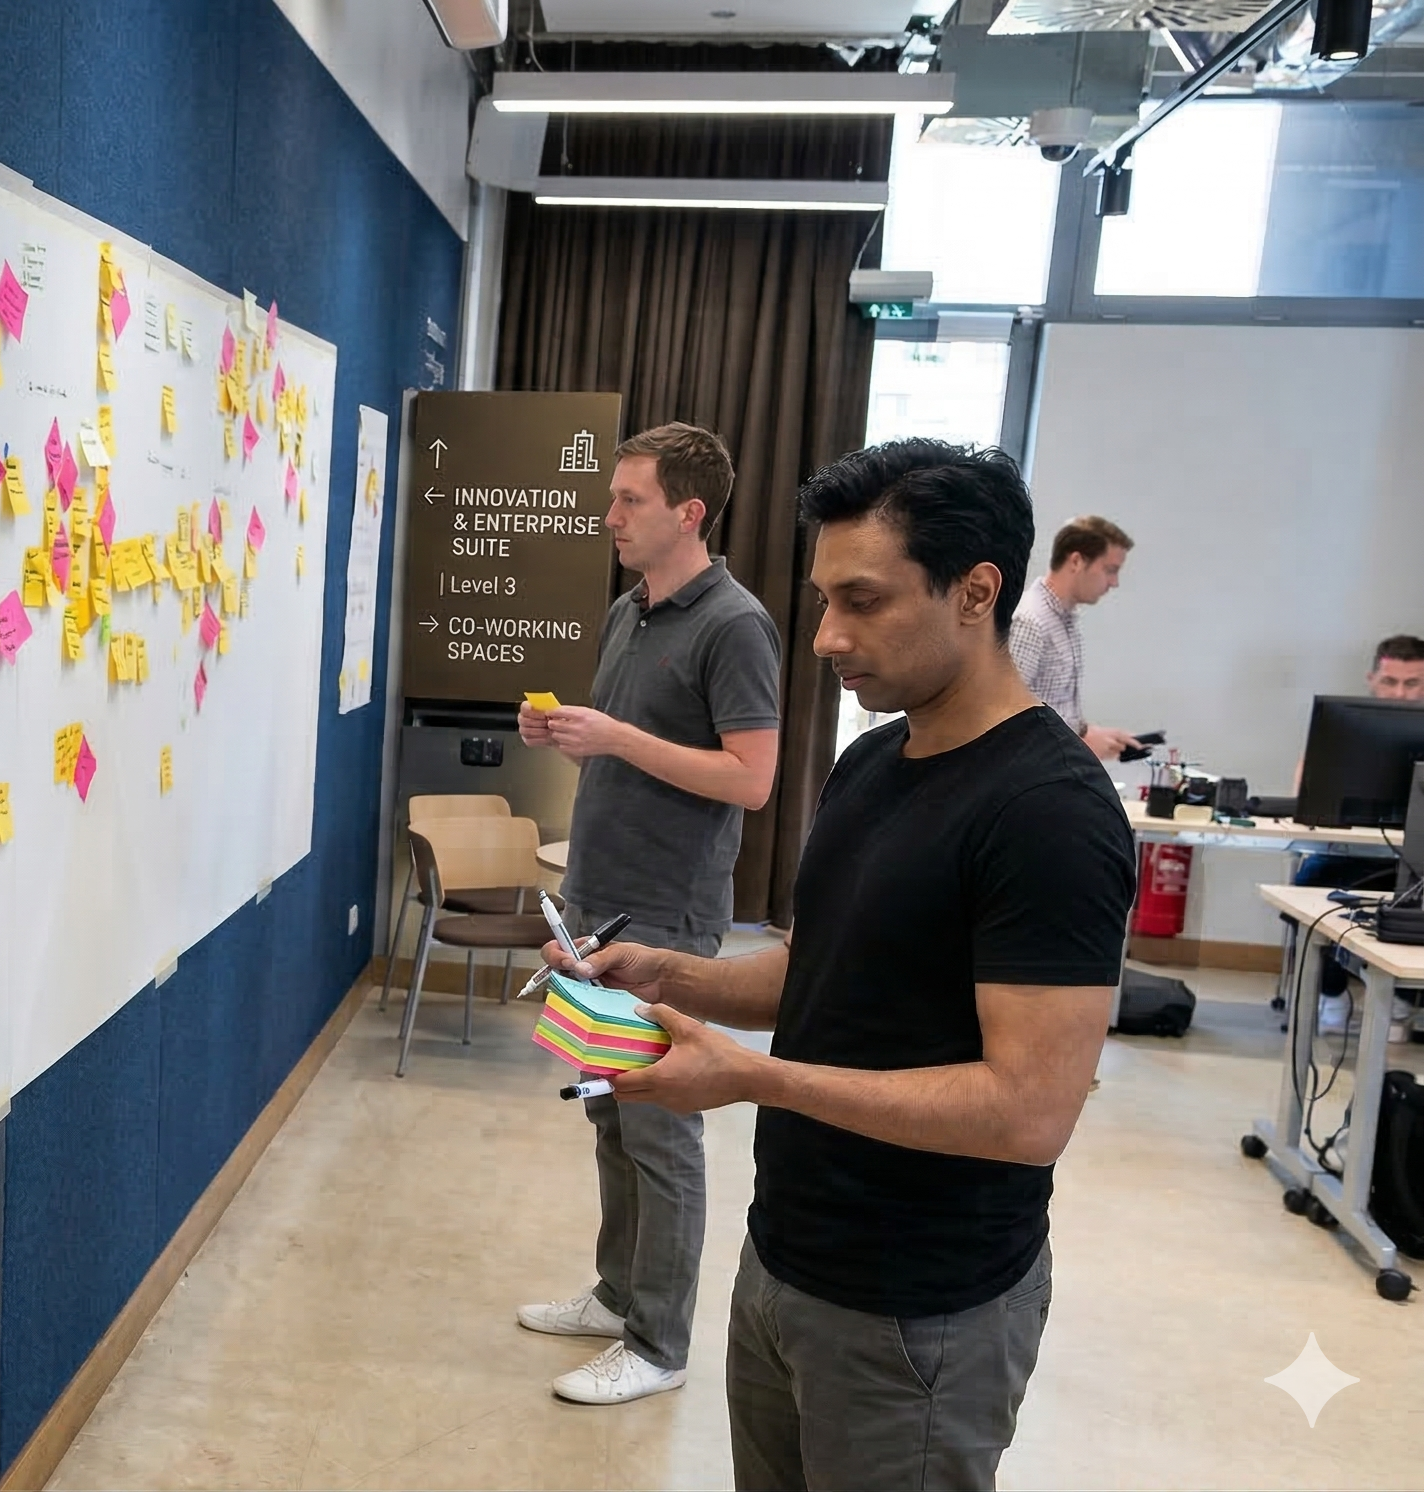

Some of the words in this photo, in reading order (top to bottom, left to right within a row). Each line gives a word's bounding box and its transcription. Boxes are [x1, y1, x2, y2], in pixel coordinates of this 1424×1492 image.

[455, 488, 577, 509] INNOVATION
[453, 513, 469, 531] &
[474, 513, 600, 535] ENTERPRISE
[452, 538, 511, 557] SUITE
[450, 576, 498, 594] Level
[504, 577, 516, 595] 3
[448, 617, 582, 640] CO-WORKING
[448, 642, 525, 663] SPACES
